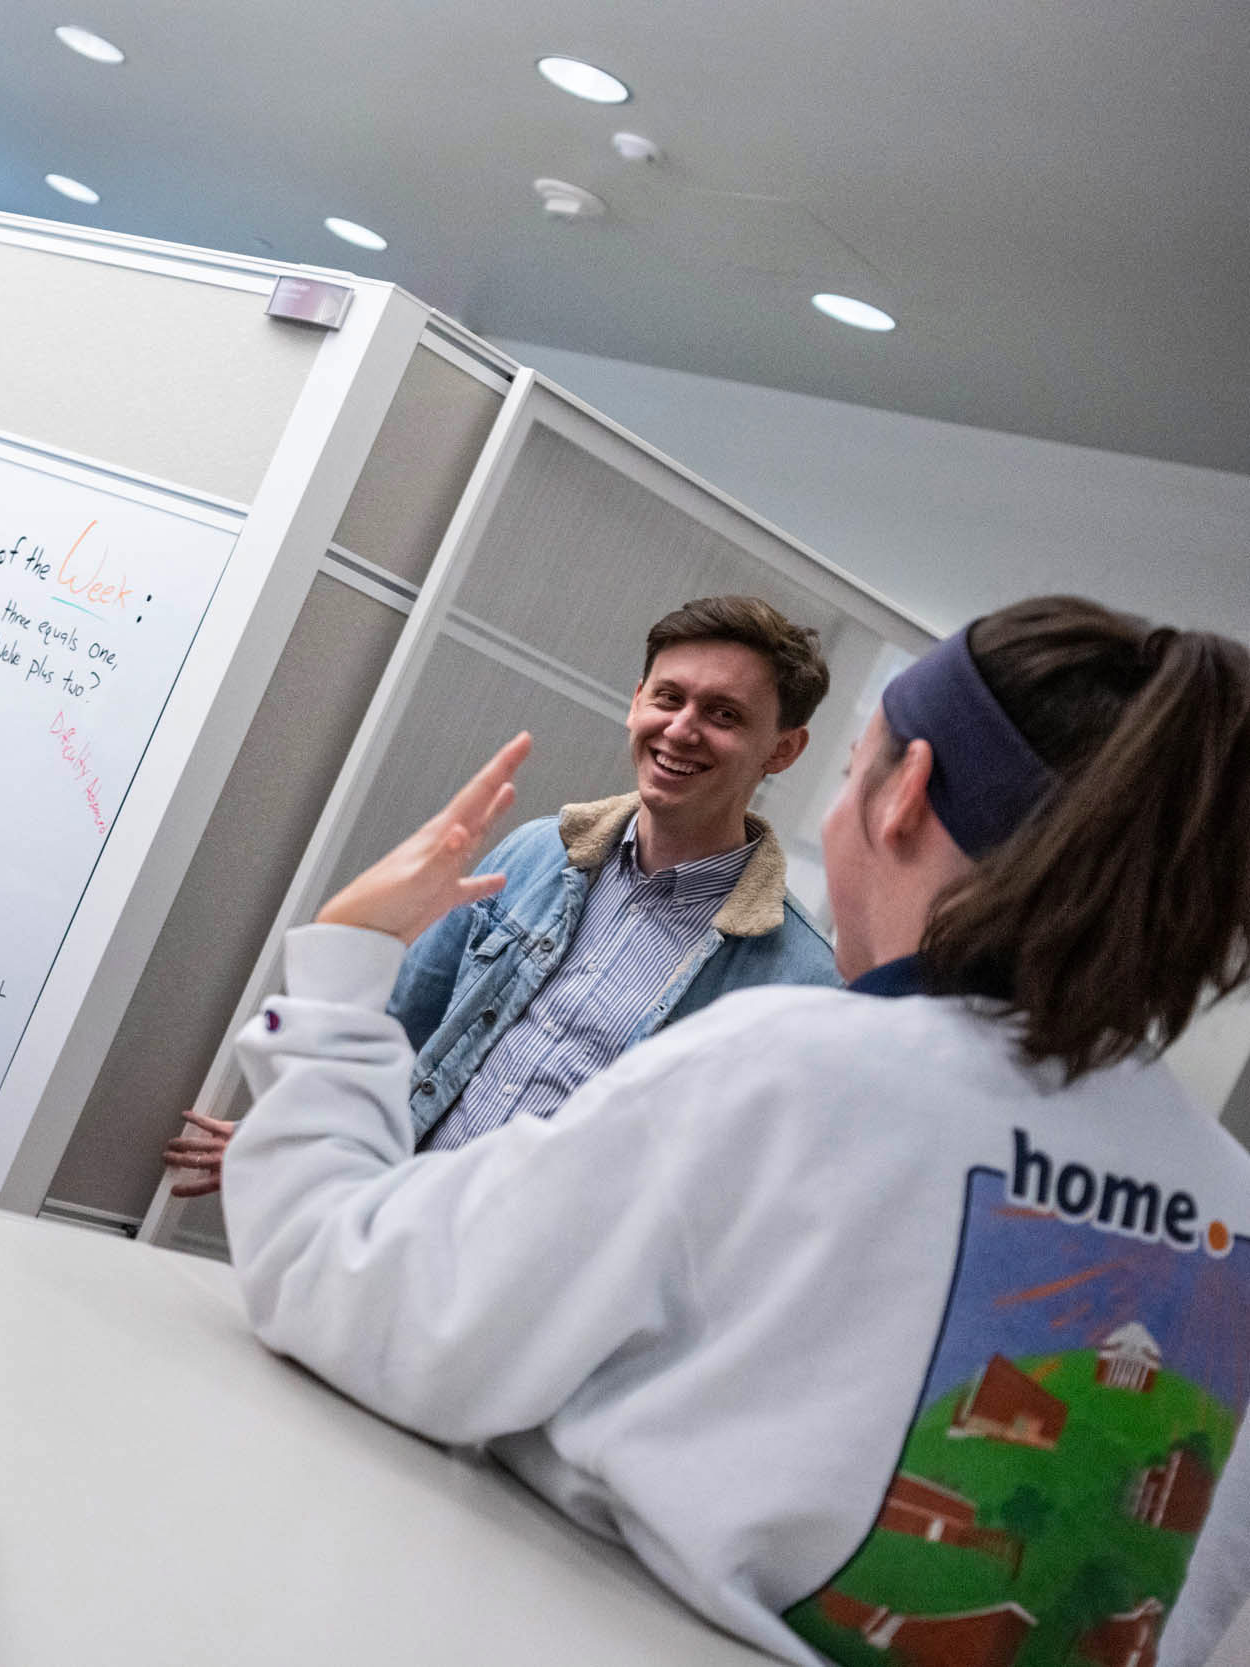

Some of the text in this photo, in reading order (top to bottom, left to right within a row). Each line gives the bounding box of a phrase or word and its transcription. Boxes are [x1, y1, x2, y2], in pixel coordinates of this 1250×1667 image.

[24, 546, 52, 581] the
[0, 599, 32, 631] three
[37, 620, 78, 652] equals
[24, 654, 55, 685] plus
